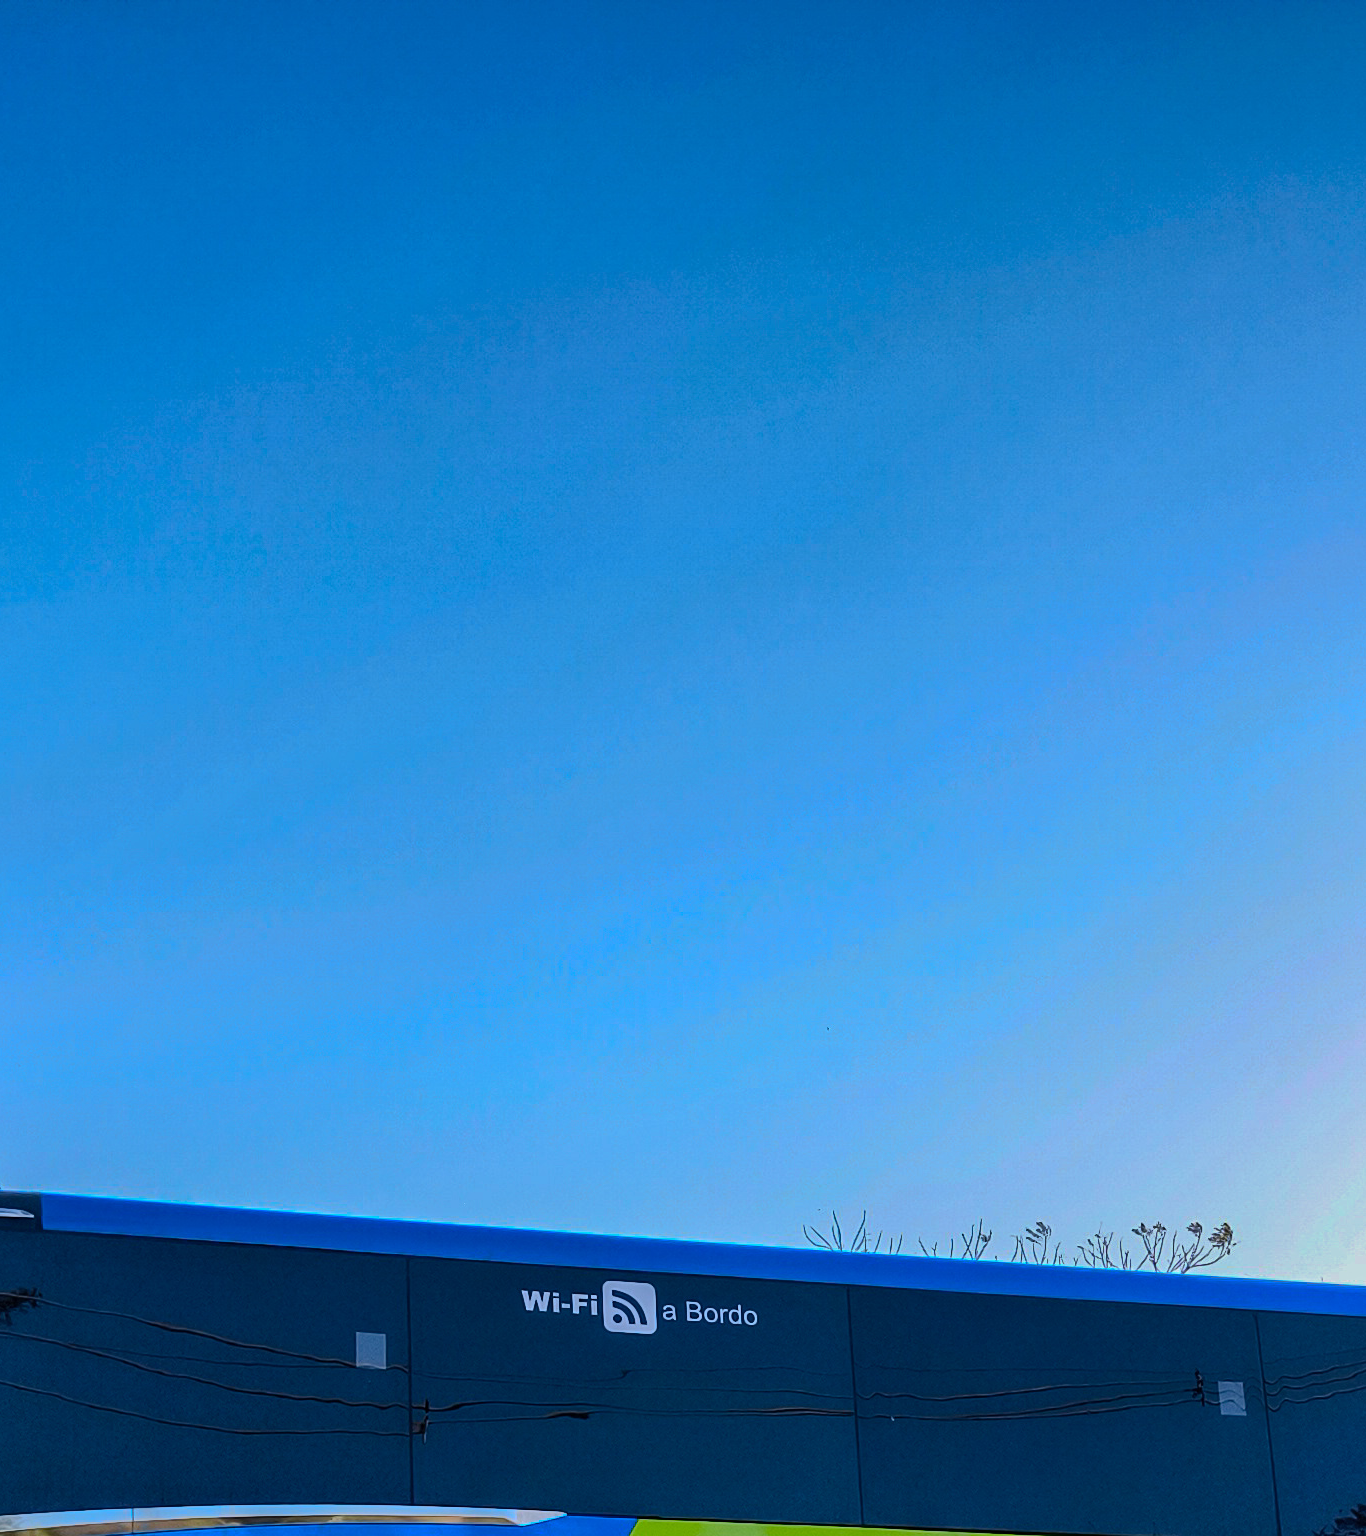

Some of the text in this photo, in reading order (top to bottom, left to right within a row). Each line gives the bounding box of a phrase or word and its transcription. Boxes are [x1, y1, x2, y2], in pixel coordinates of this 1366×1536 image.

[521, 1289, 758, 1326] Wi-Fi a Bordo
